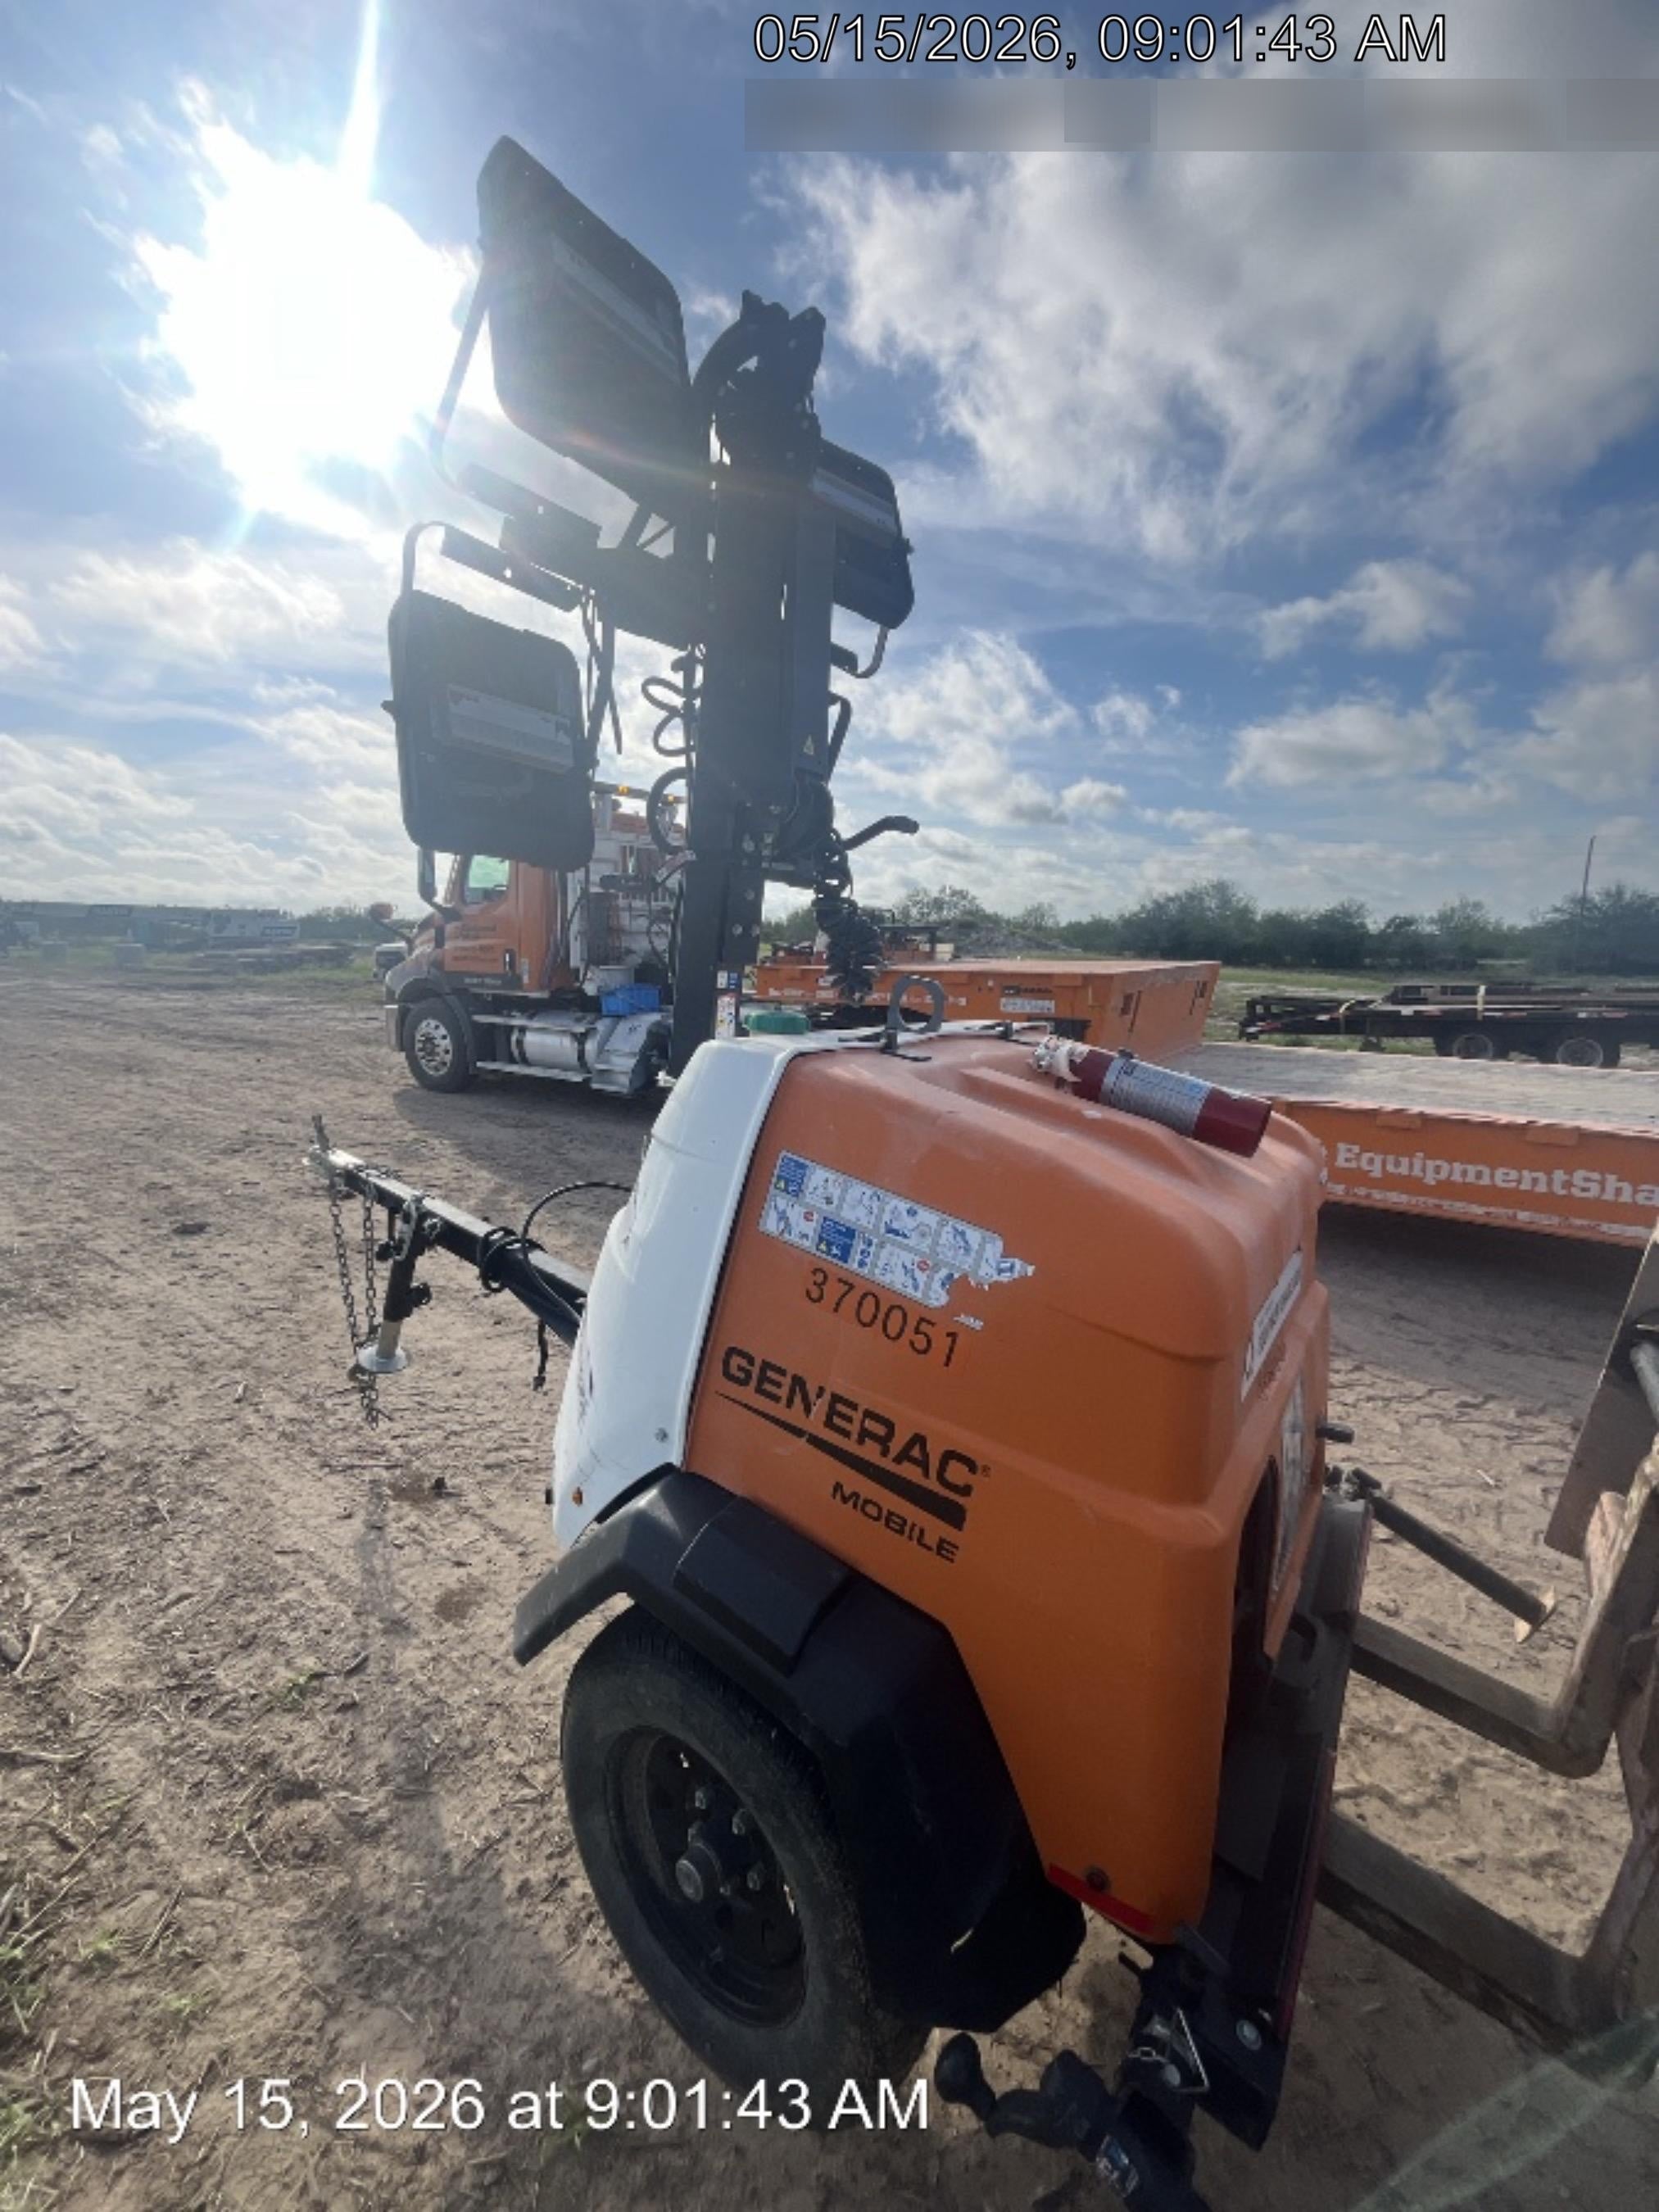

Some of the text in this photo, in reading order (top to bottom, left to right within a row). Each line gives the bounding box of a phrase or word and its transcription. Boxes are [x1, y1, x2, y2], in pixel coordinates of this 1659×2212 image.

[805, 1267, 958, 1367] 370051
[722, 1345, 979, 1498] GENERAC
[832, 1480, 959, 1563] MOBILE
